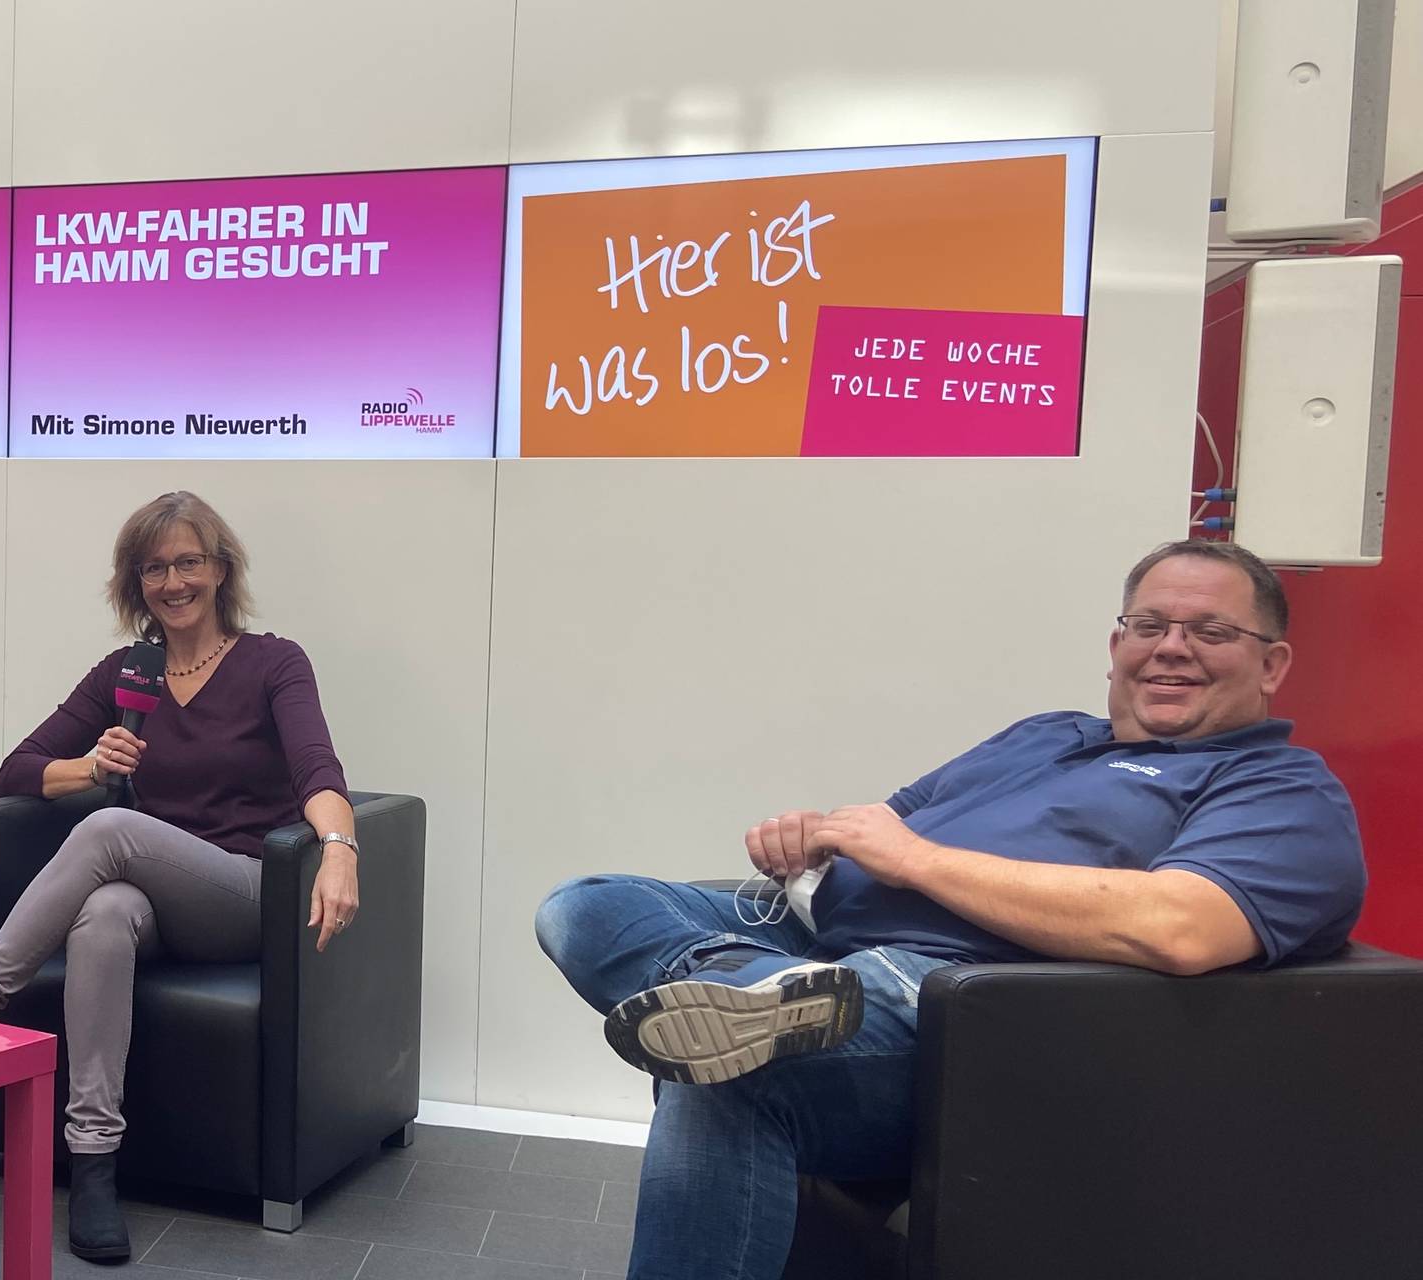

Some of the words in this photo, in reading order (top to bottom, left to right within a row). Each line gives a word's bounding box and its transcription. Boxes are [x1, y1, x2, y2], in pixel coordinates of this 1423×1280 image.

[34, 204, 305, 246] LKW-FAHRER
[321, 201, 369, 237] IN
[34, 248, 170, 285] HAMM
[184, 241, 389, 280] GESUCHT
[597, 230, 732, 313] Hier
[748, 200, 836, 287] ist
[545, 344, 659, 415] was
[680, 300, 789, 394] los!
[854, 337, 926, 362] JEDE
[947, 342, 1042, 367] WOCHE
[831, 373, 920, 399] TOLLE
[941, 379, 1056, 406] EVENTS
[30, 414, 74, 436] Mit
[83, 415, 175, 435] Simone
[184, 413, 307, 435] Niewerth
[361, 403, 408, 414] RADIO
[361, 415, 455, 426] LIPPEWELLE
